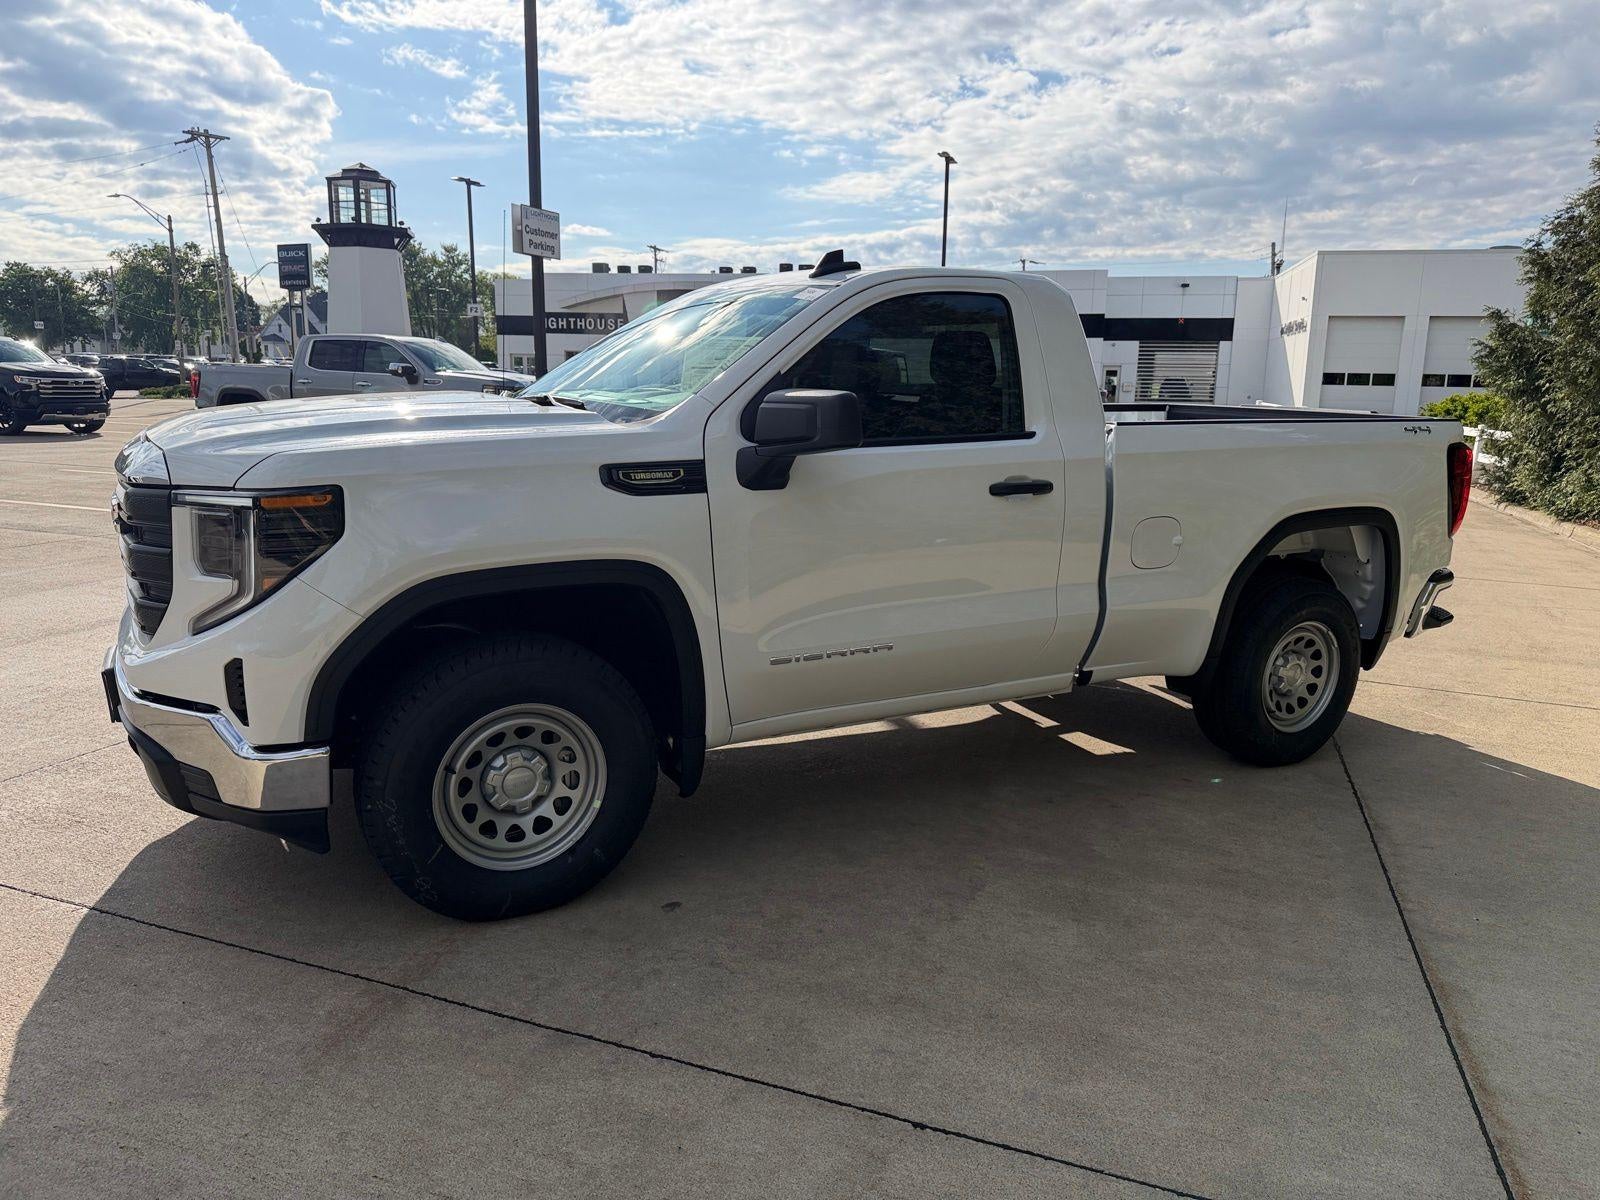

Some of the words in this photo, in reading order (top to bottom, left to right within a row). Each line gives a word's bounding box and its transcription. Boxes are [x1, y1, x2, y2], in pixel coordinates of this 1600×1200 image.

[524, 224, 558, 240] Customer
[529, 238, 555, 255] Parking
[281, 264, 305, 272] GMC
[545, 317, 625, 330] IGHTHOUSE
[630, 471, 674, 480] TURBOMAX
[769, 642, 894, 665] SIERRA
